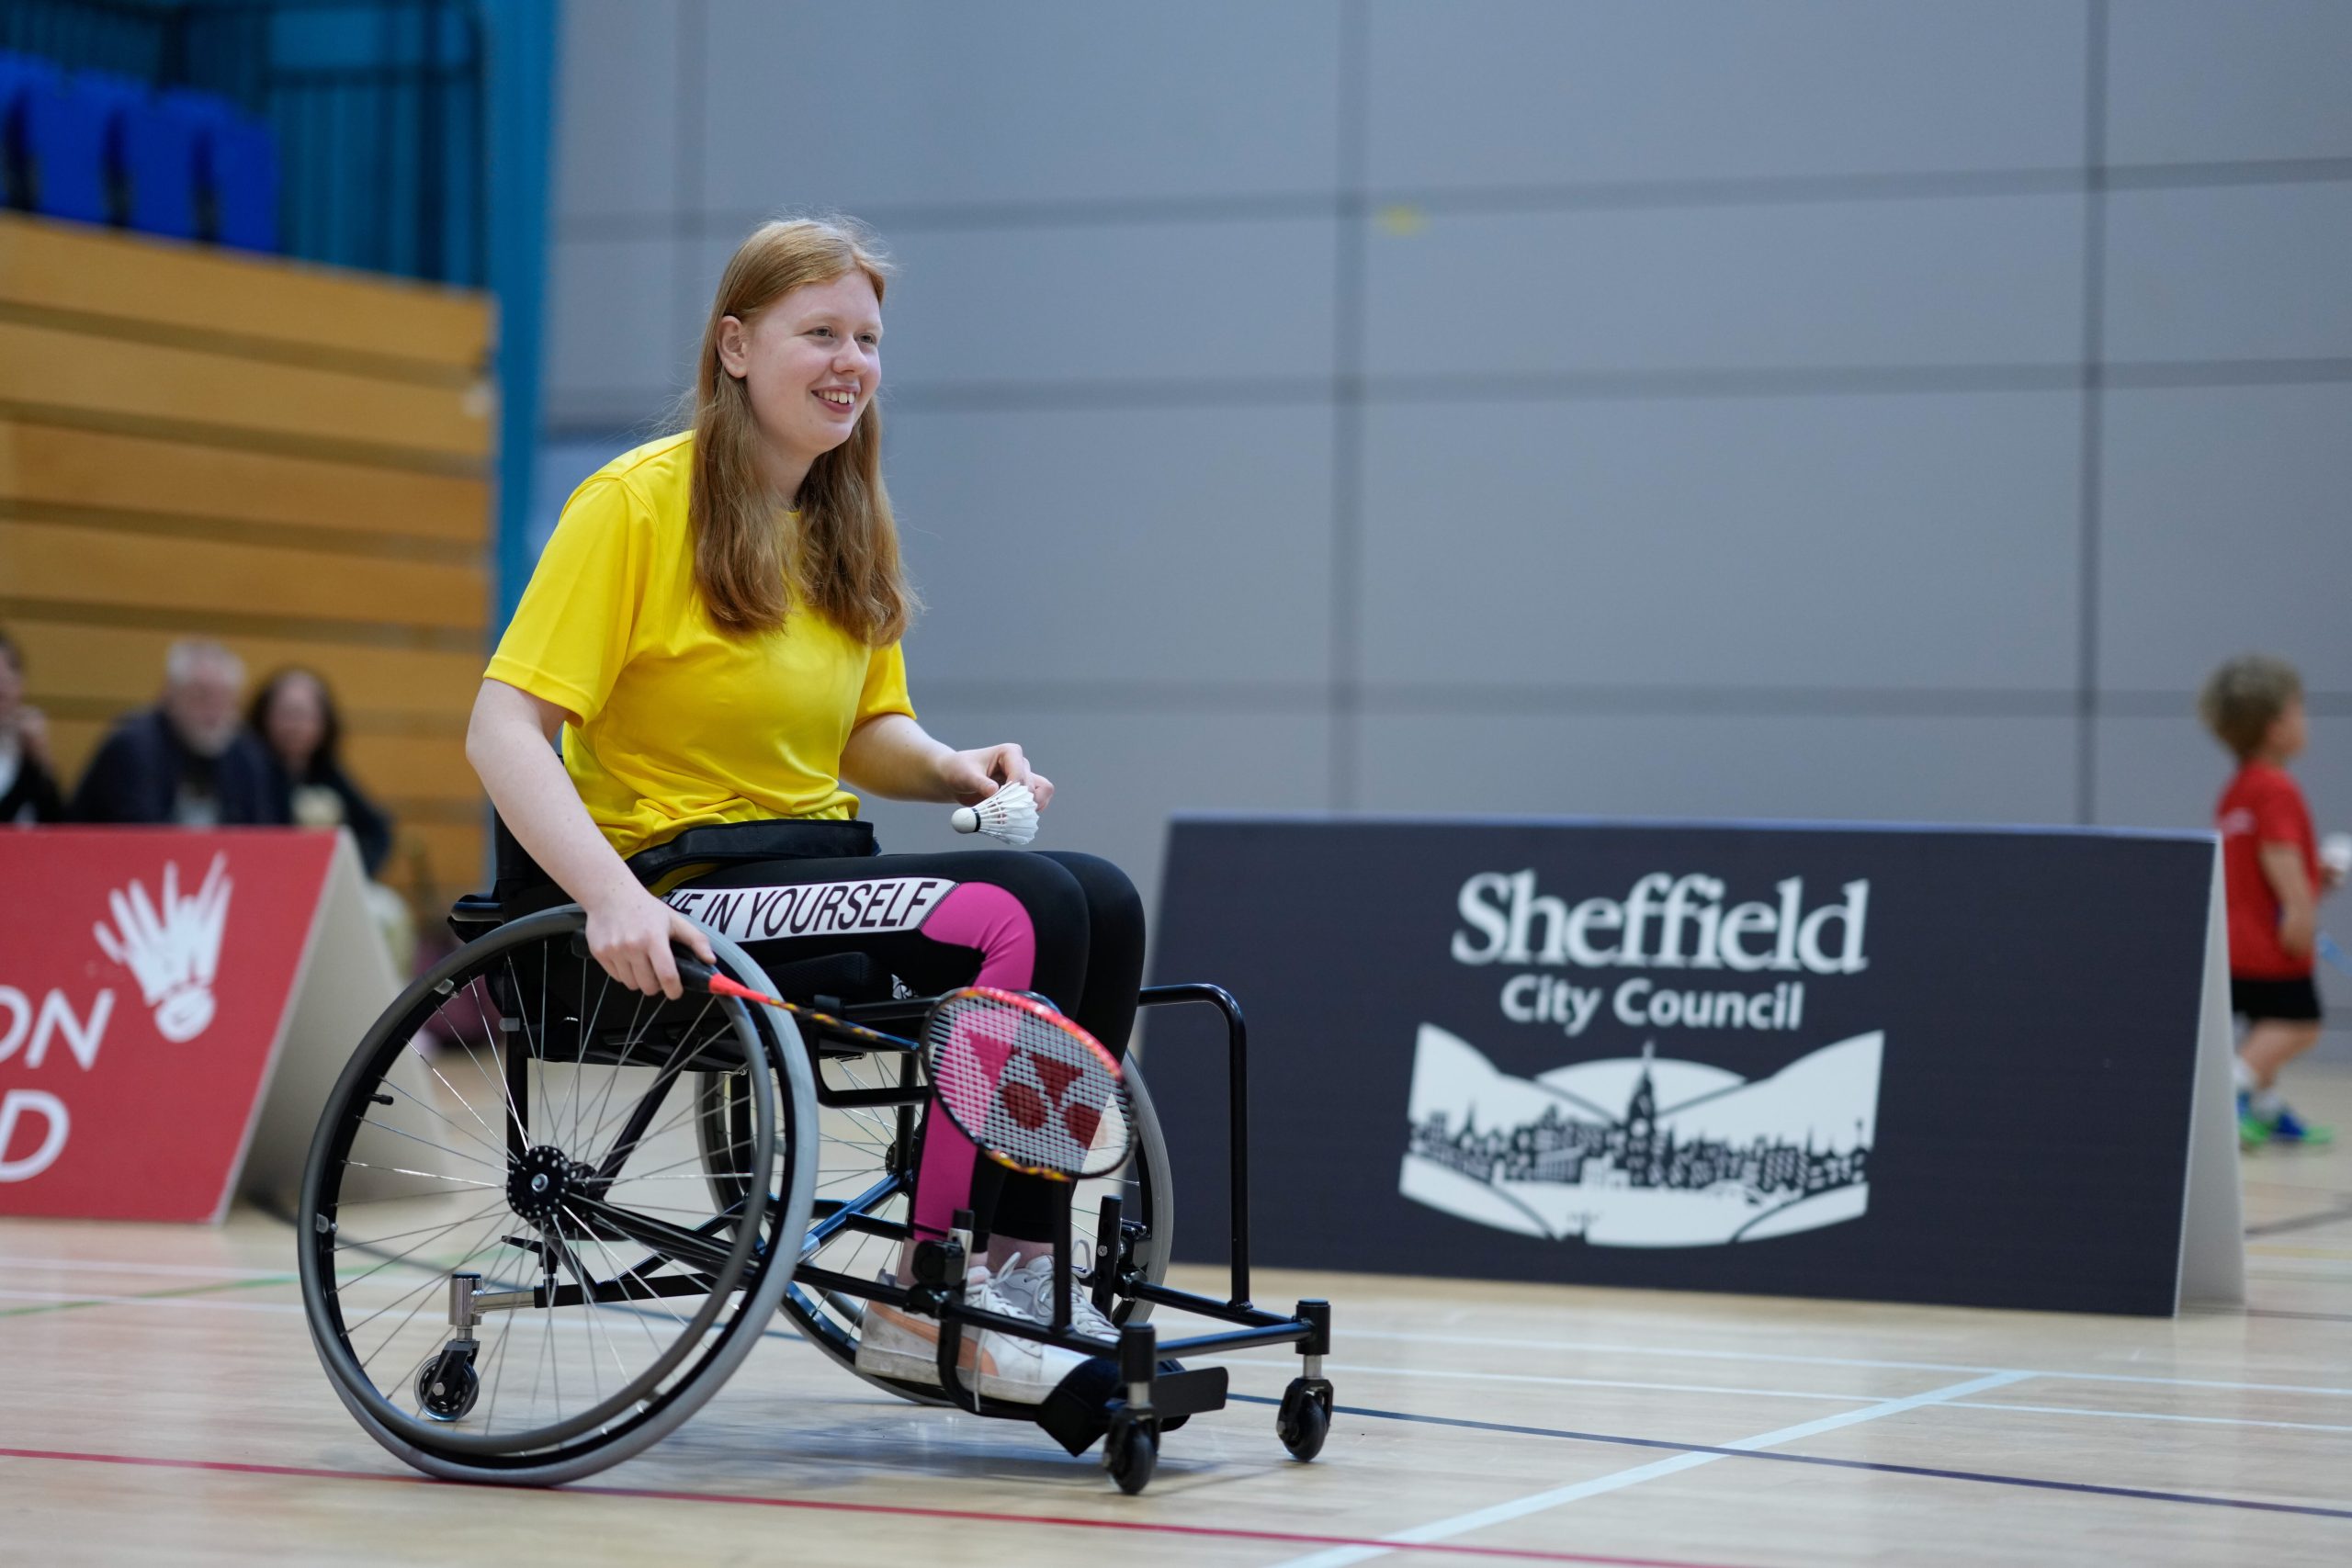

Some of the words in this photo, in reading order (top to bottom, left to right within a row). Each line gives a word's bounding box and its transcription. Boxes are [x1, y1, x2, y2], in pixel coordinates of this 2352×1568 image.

[701, 893, 745, 935] IN
[745, 881, 938, 938] YOURSELF
[1452, 868, 1870, 974] Sheffield
[1500, 974, 1602, 1037] City
[1612, 977, 1804, 1030] Council
